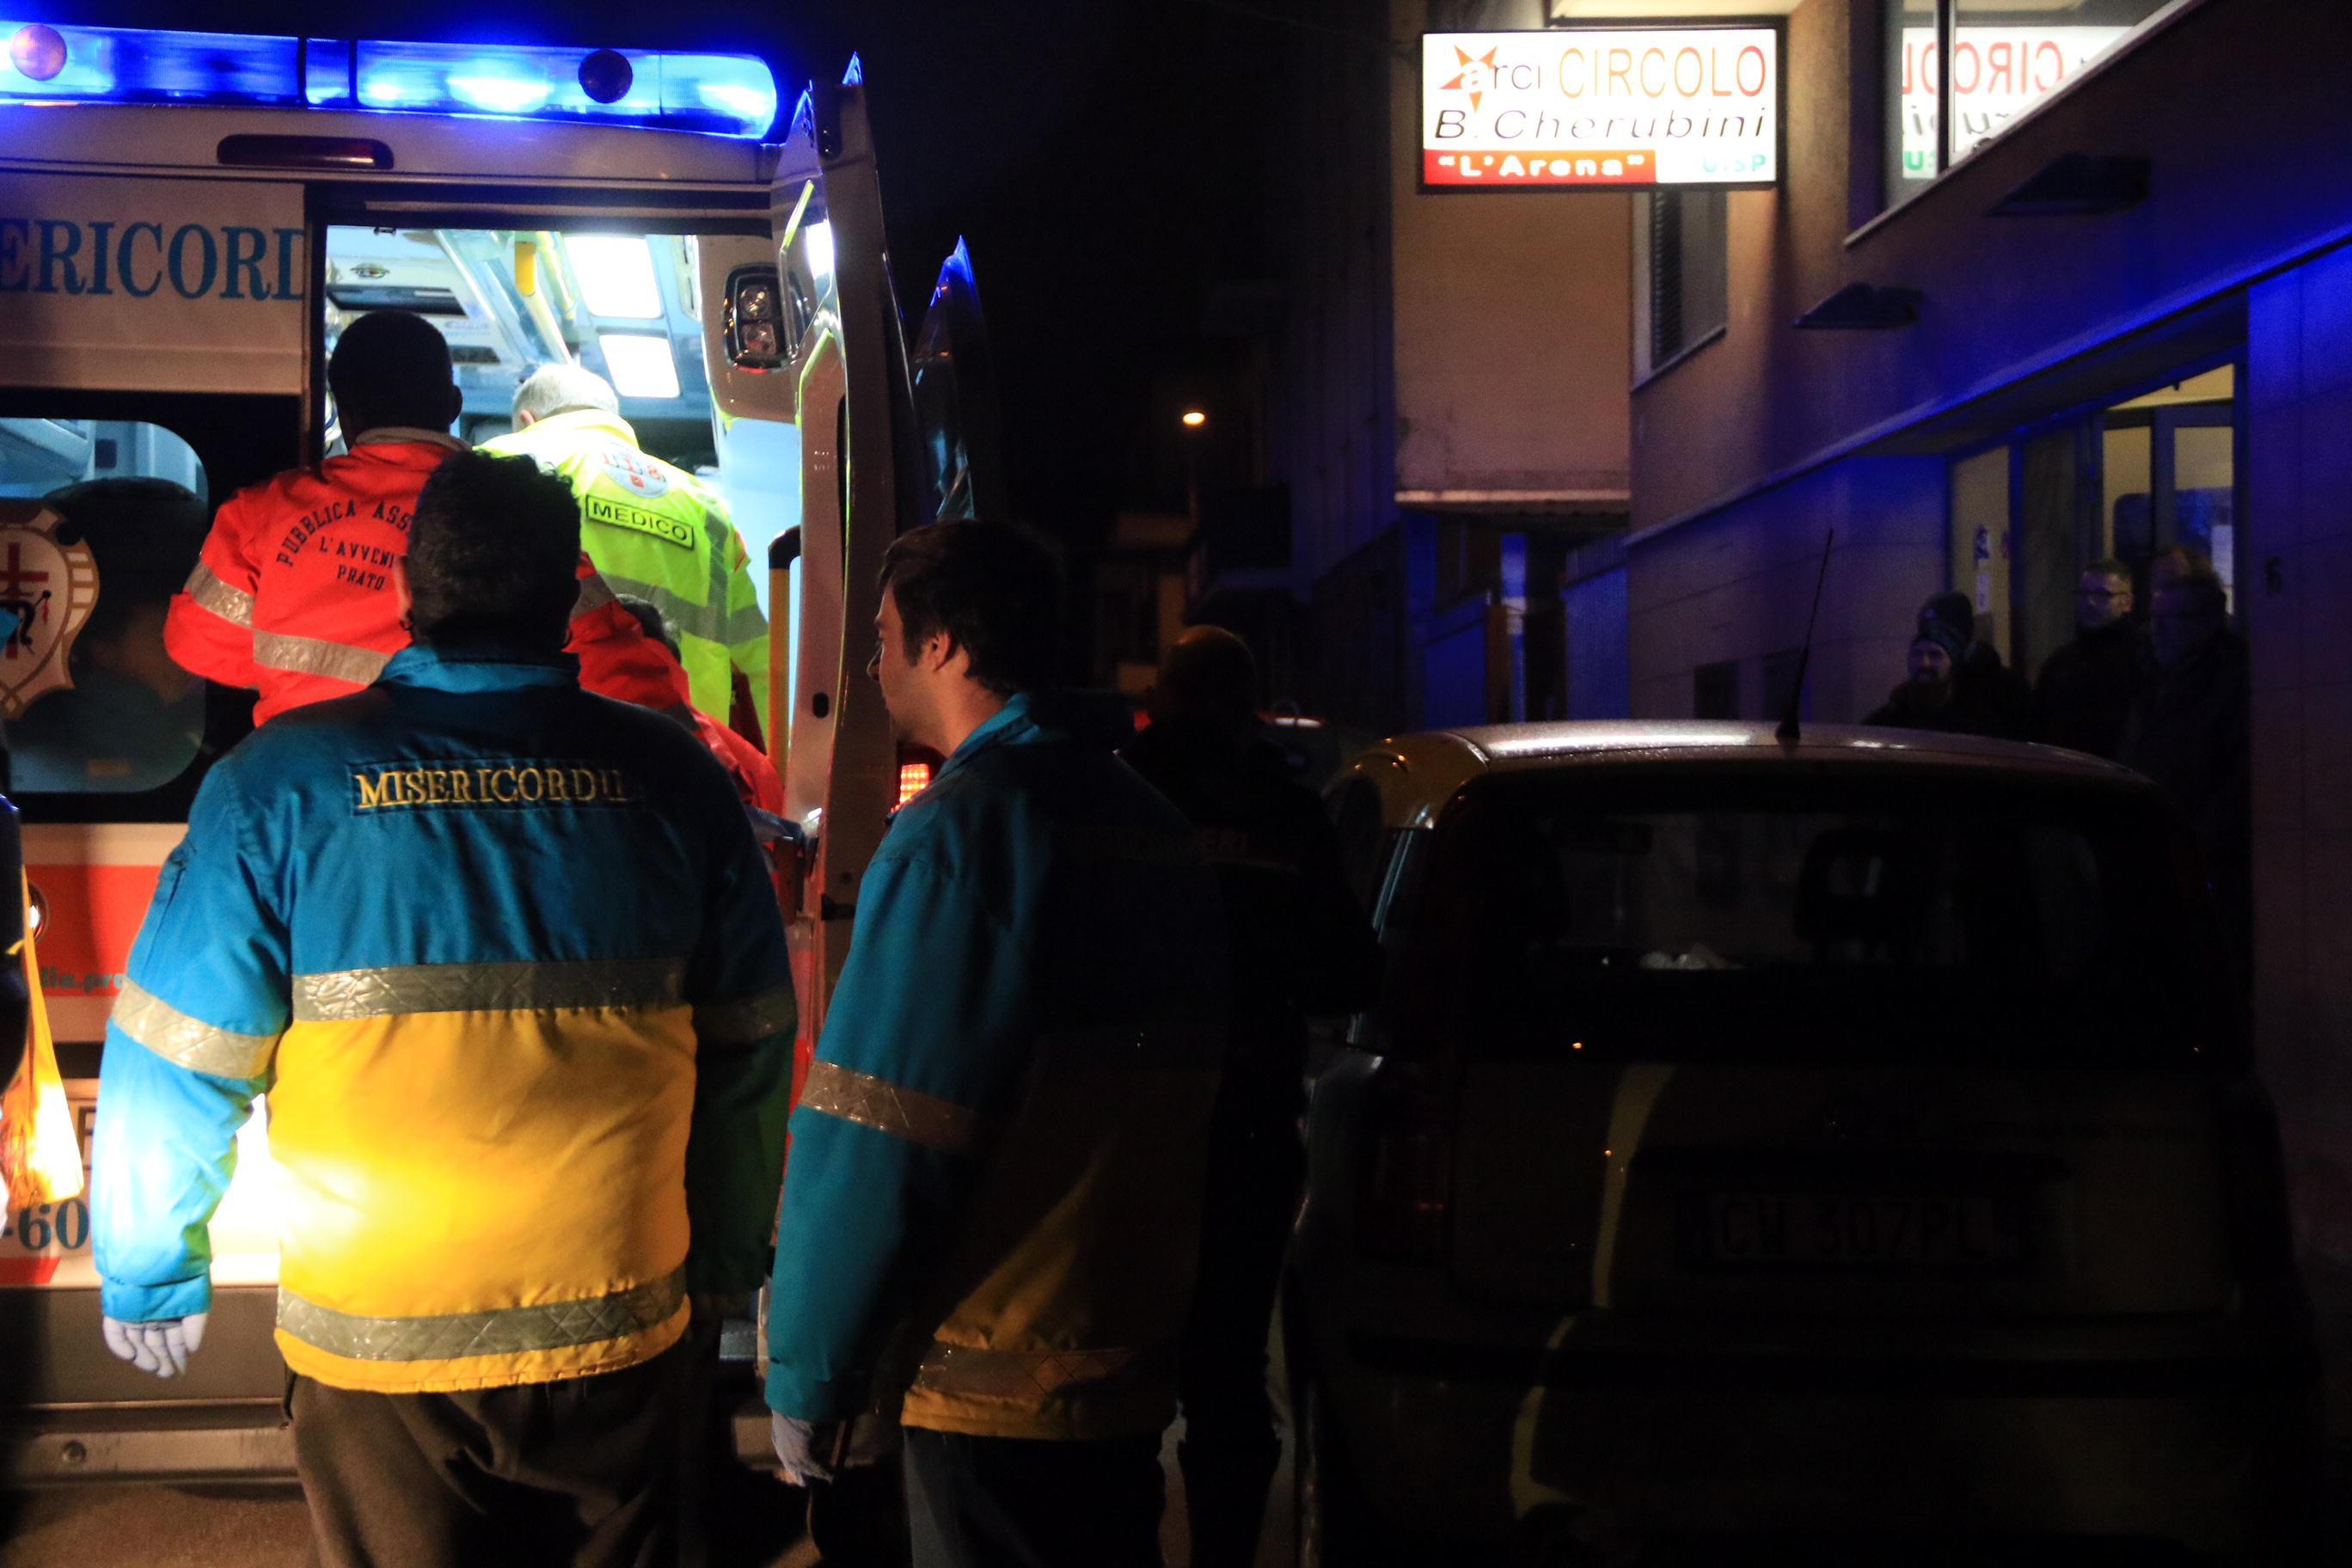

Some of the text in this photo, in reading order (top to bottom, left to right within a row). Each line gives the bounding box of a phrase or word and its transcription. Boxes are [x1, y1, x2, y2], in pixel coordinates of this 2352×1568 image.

[1559, 45, 1767, 98] CIRCOLO
[1494, 106, 1767, 139] Cherubini
[275, 499, 357, 567] PUBBLICA
[593, 501, 688, 541] MEDICO
[336, 564, 385, 591] PRATO
